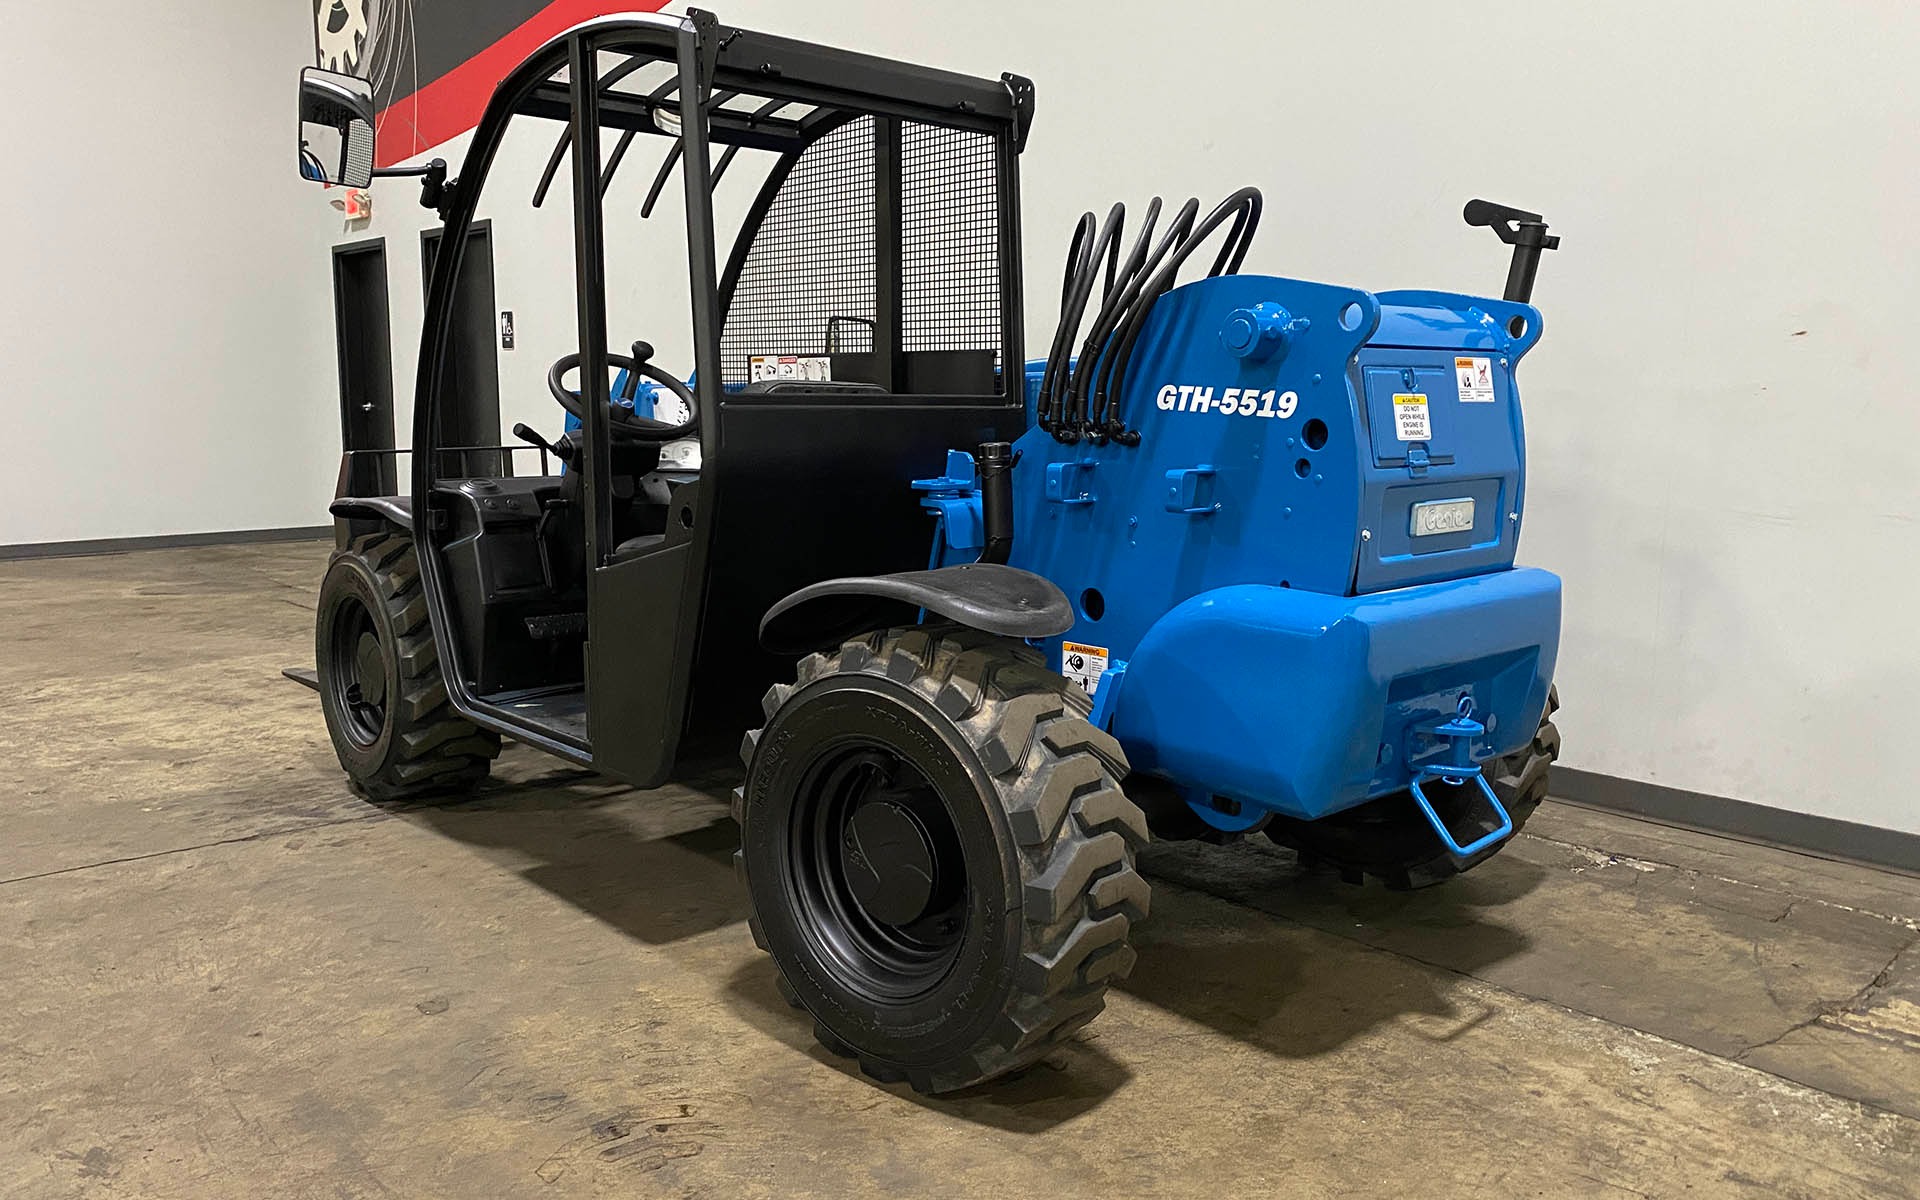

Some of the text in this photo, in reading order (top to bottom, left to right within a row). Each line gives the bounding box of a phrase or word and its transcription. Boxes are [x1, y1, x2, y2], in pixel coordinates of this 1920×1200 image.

[1156, 384, 1299, 419] GTH-5519
[1412, 413, 1425, 421] WHILE
[1403, 421, 1418, 429] ENGINE
[1405, 429, 1424, 437] RUNNING
[1424, 507, 1465, 531] Genie
